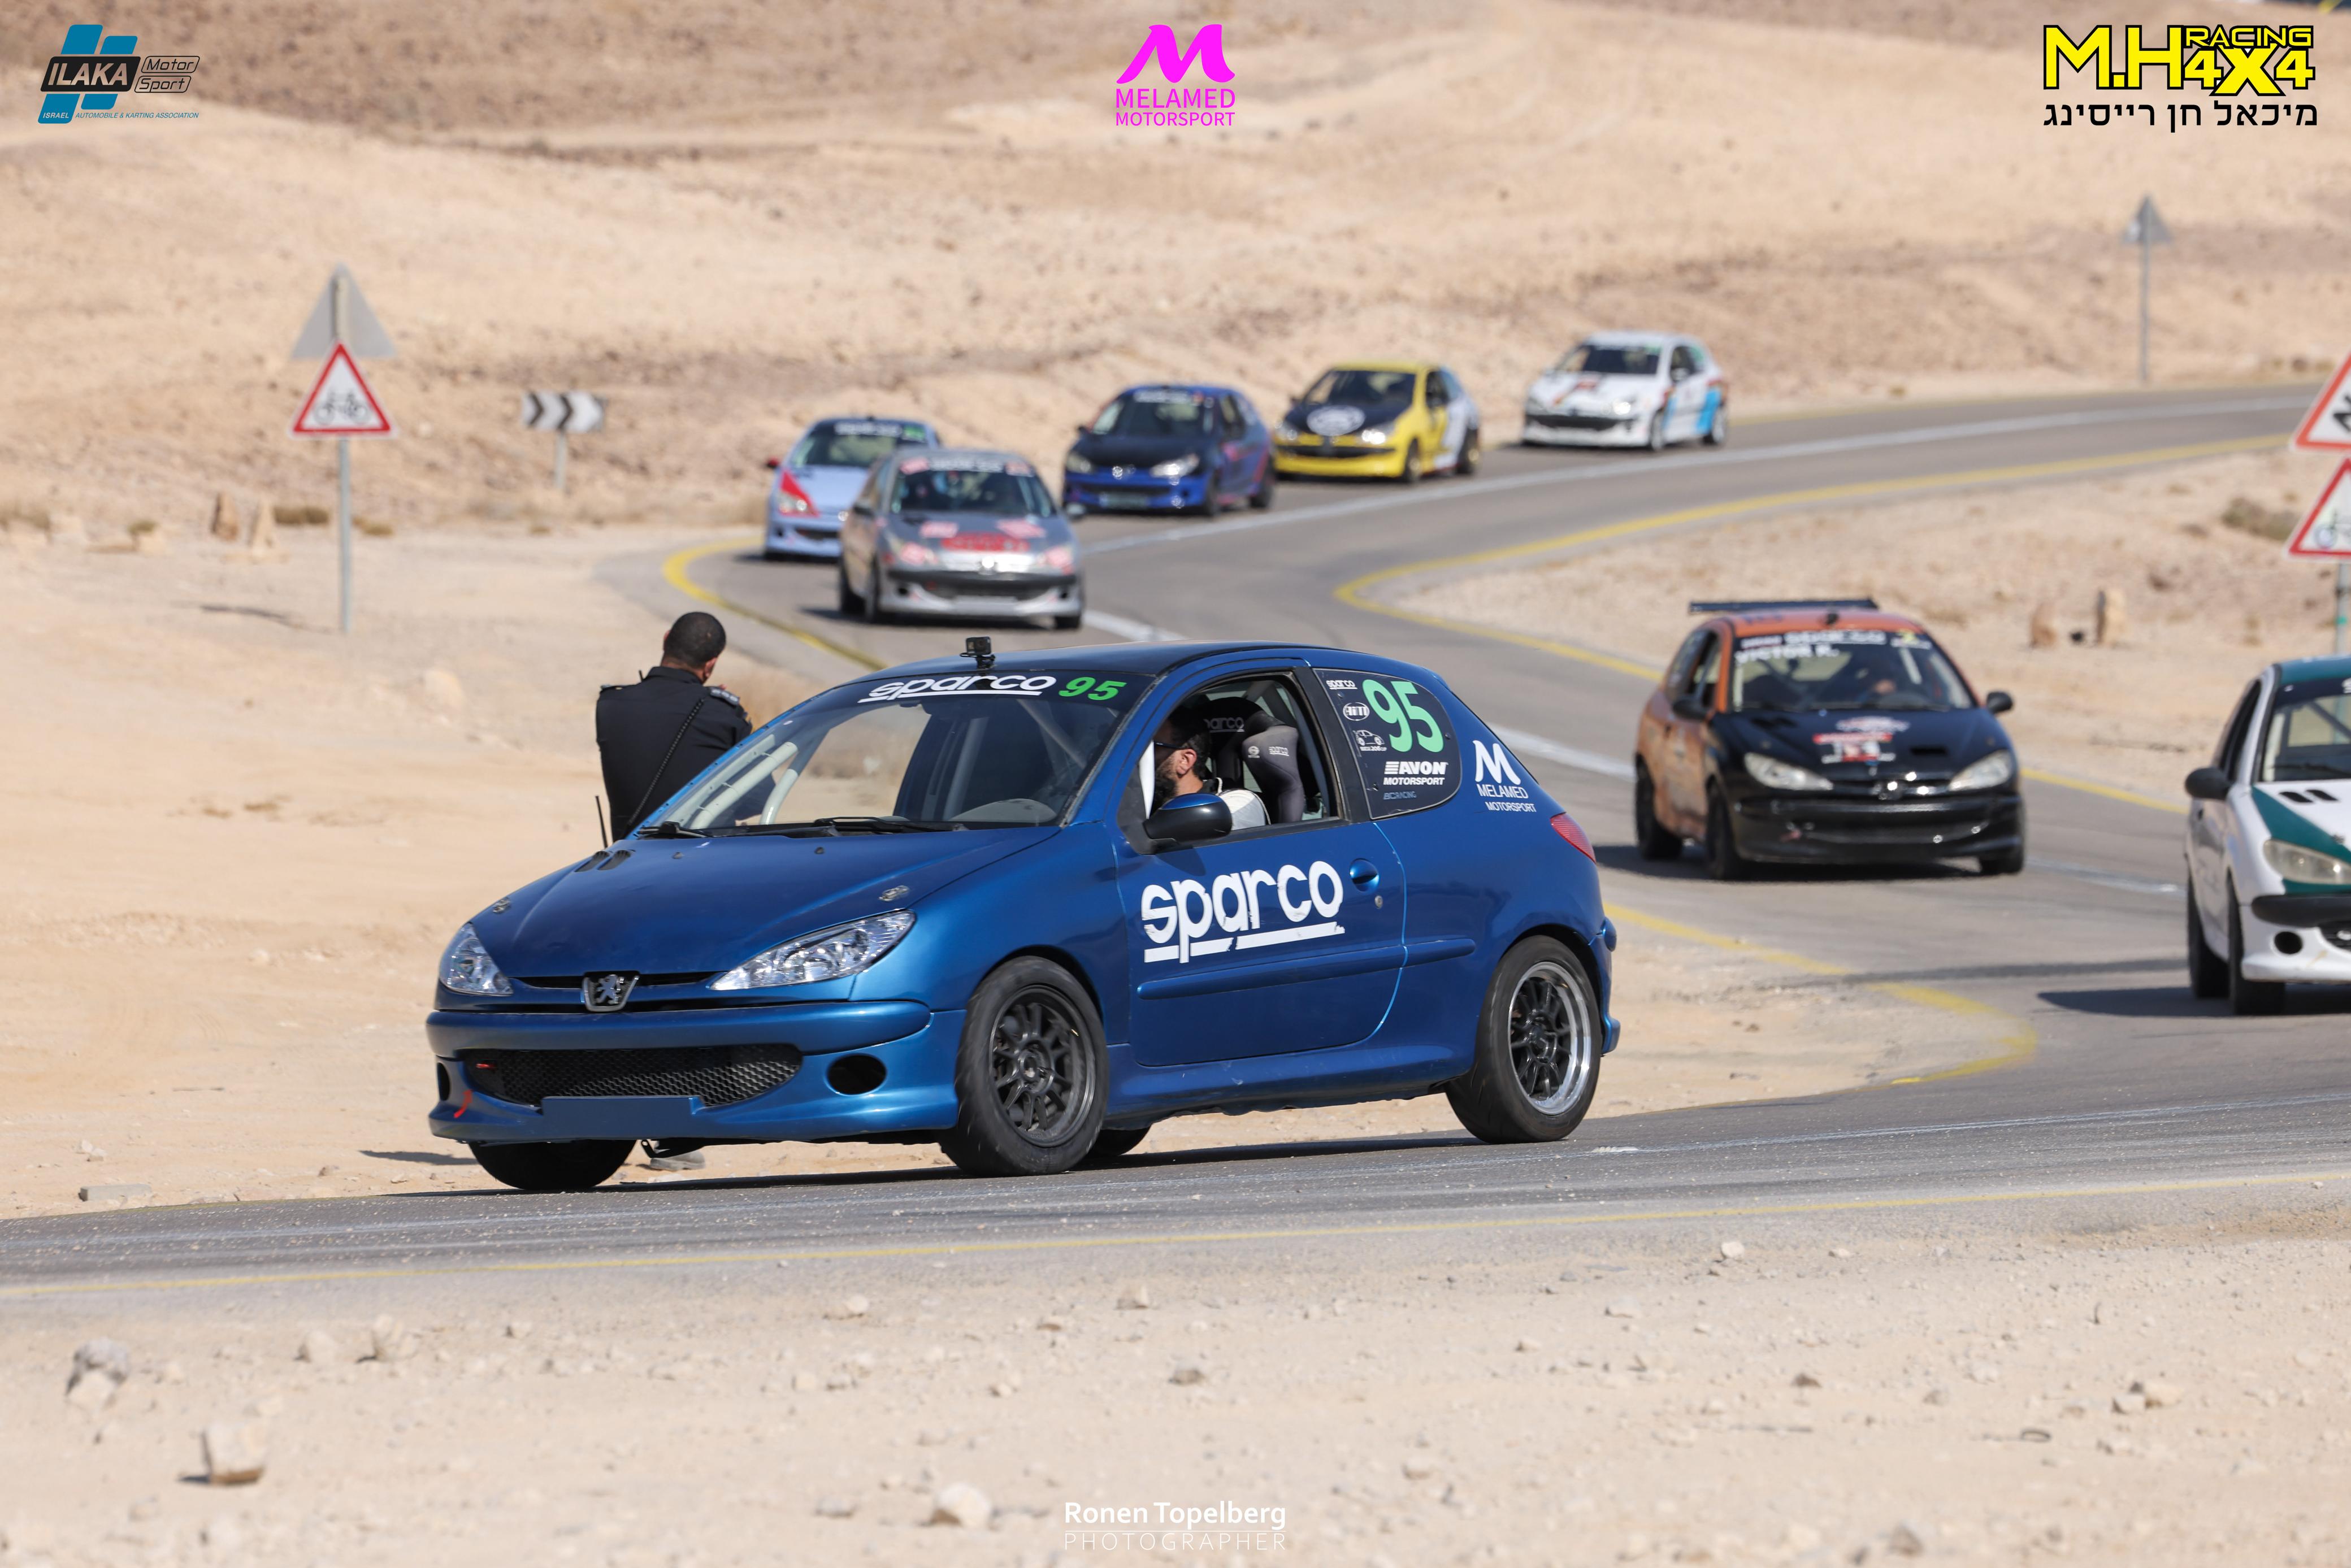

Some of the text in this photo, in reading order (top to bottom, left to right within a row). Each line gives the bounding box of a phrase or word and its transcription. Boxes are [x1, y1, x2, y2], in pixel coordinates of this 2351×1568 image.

[868, 675, 1127, 701] sparco 95
[1326, 680, 1356, 689] sparco
[1362, 679, 1444, 753] 95
[1398, 761, 1447, 775] AVON
[1383, 777, 1445, 785] MOTORSPORT
[1476, 784, 1529, 798] MELAMED
[1485, 802, 1537, 812] MOTORSPORT
[1141, 861, 1344, 963] sparco
